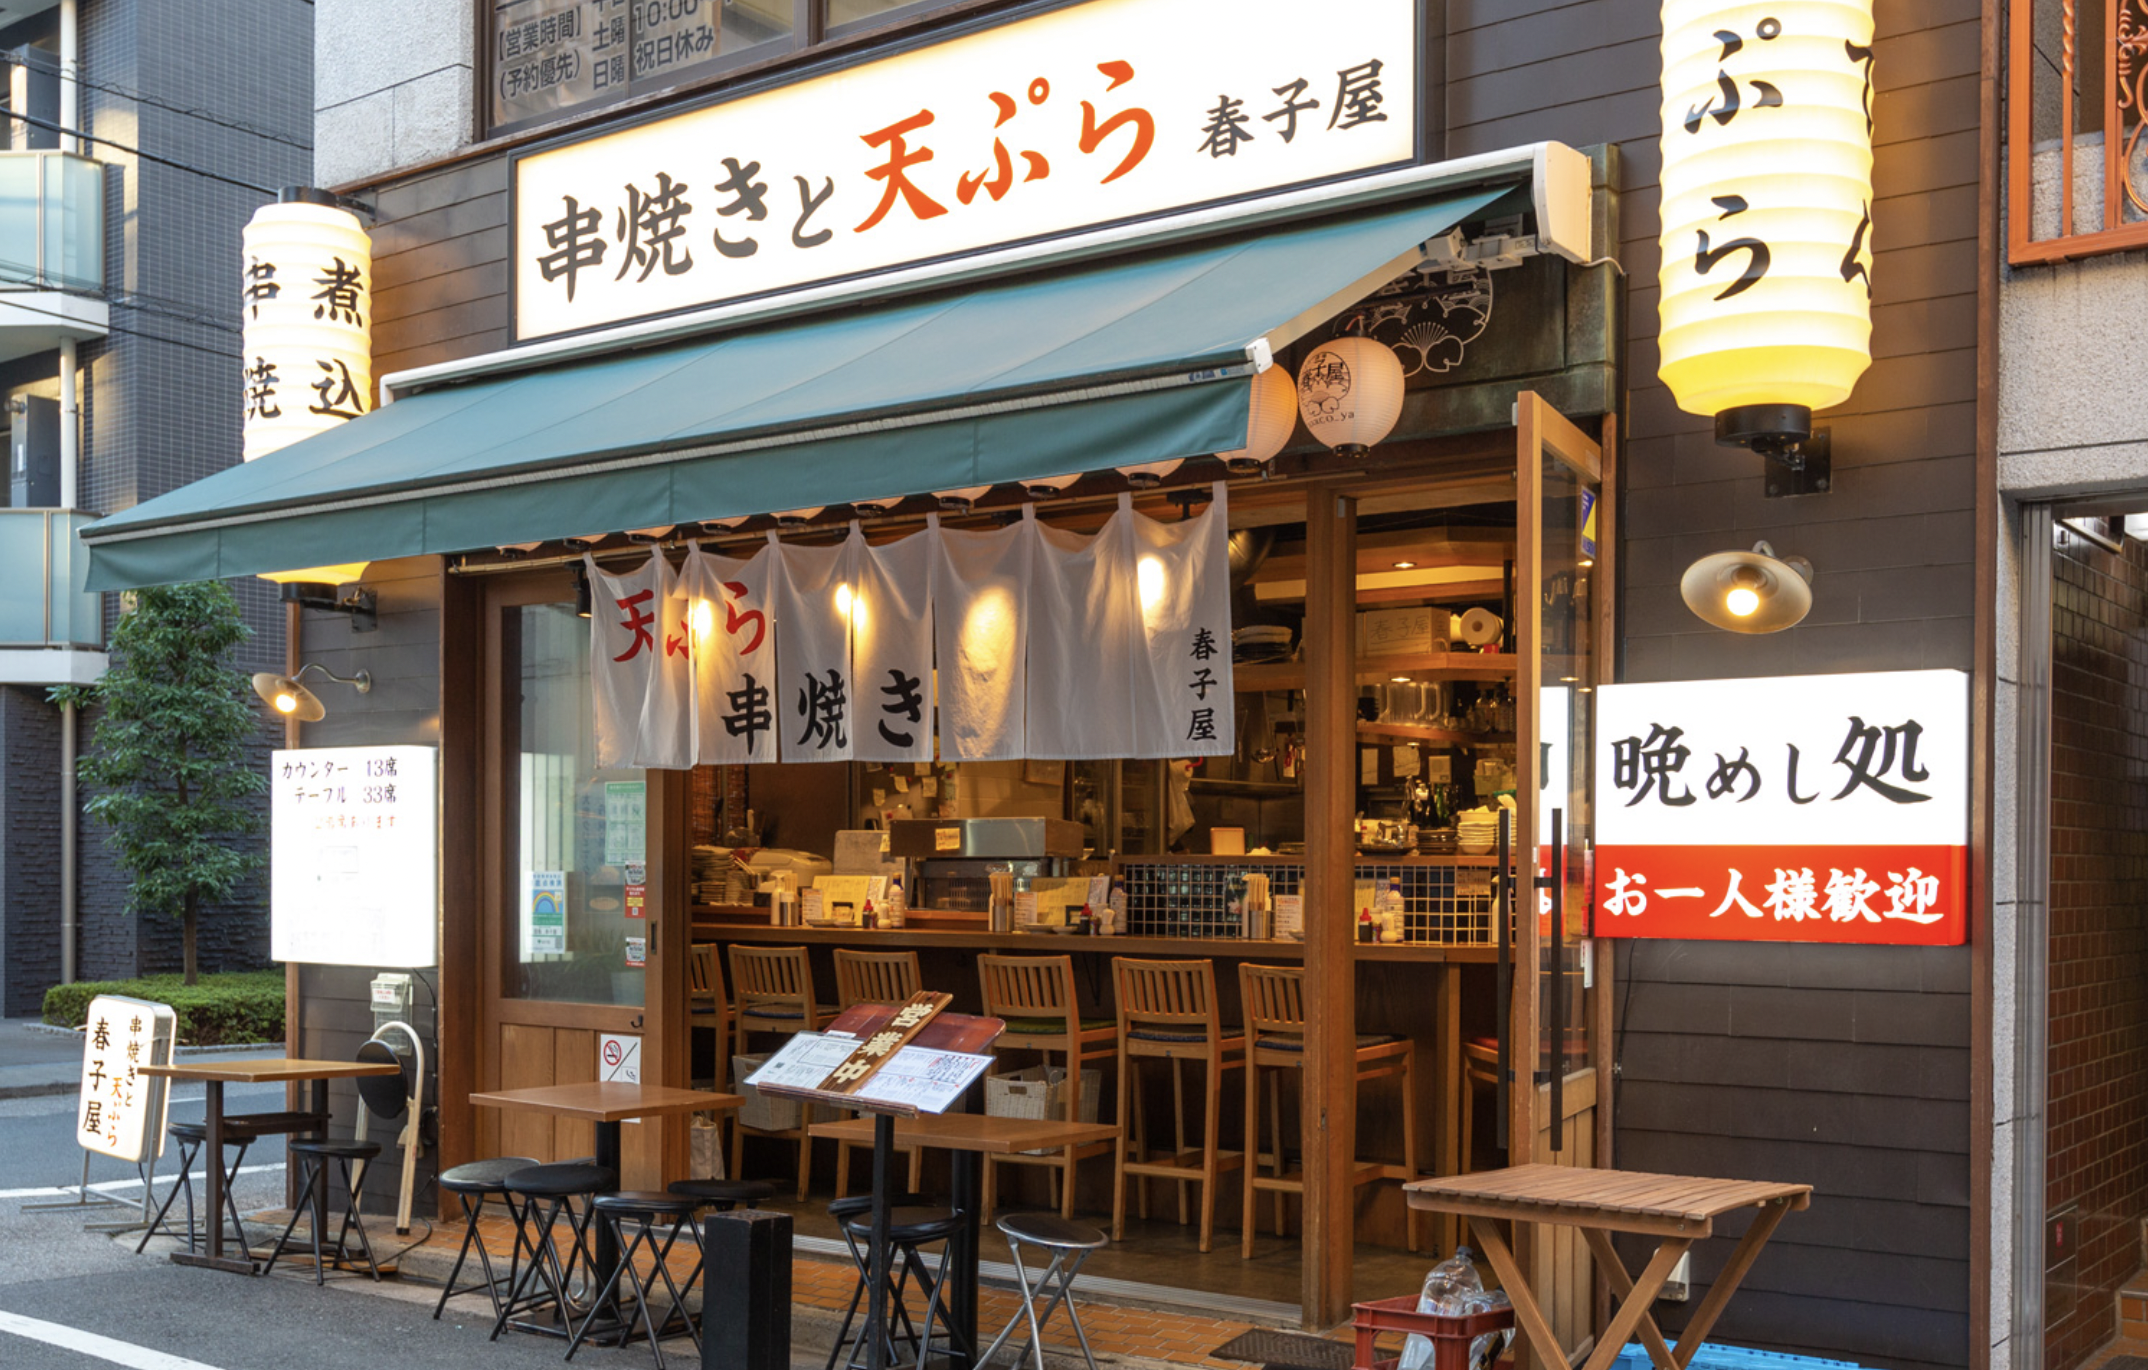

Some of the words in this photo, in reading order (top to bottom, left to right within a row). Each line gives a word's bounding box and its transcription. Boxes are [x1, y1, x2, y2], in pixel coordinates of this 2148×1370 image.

[500, 14, 582, 61] 【営業時間】
[636, 25, 714, 73] 祝日休み
[536, 60, 1155, 303] 串焼きと天ぷら
[1197, 58, 1389, 159] 春子屋
[1684, 17, 1783, 301] ぷら
[309, 256, 364, 420] 煮込
[720, 669, 923, 755] 串焼き
[1186, 627, 1218, 741] 春子屋
[282, 760, 348, 779] カウンター
[366, 757, 397, 778] 13席
[1611, 716, 1933, 807] 晩めし処
[1603, 867, 1944, 924] お一人様歓迎
[83, 1015, 111, 1135] 春子屋
[125, 1014, 142, 1107] 串焼きと
[832, 1002, 934, 1084] 営業中
